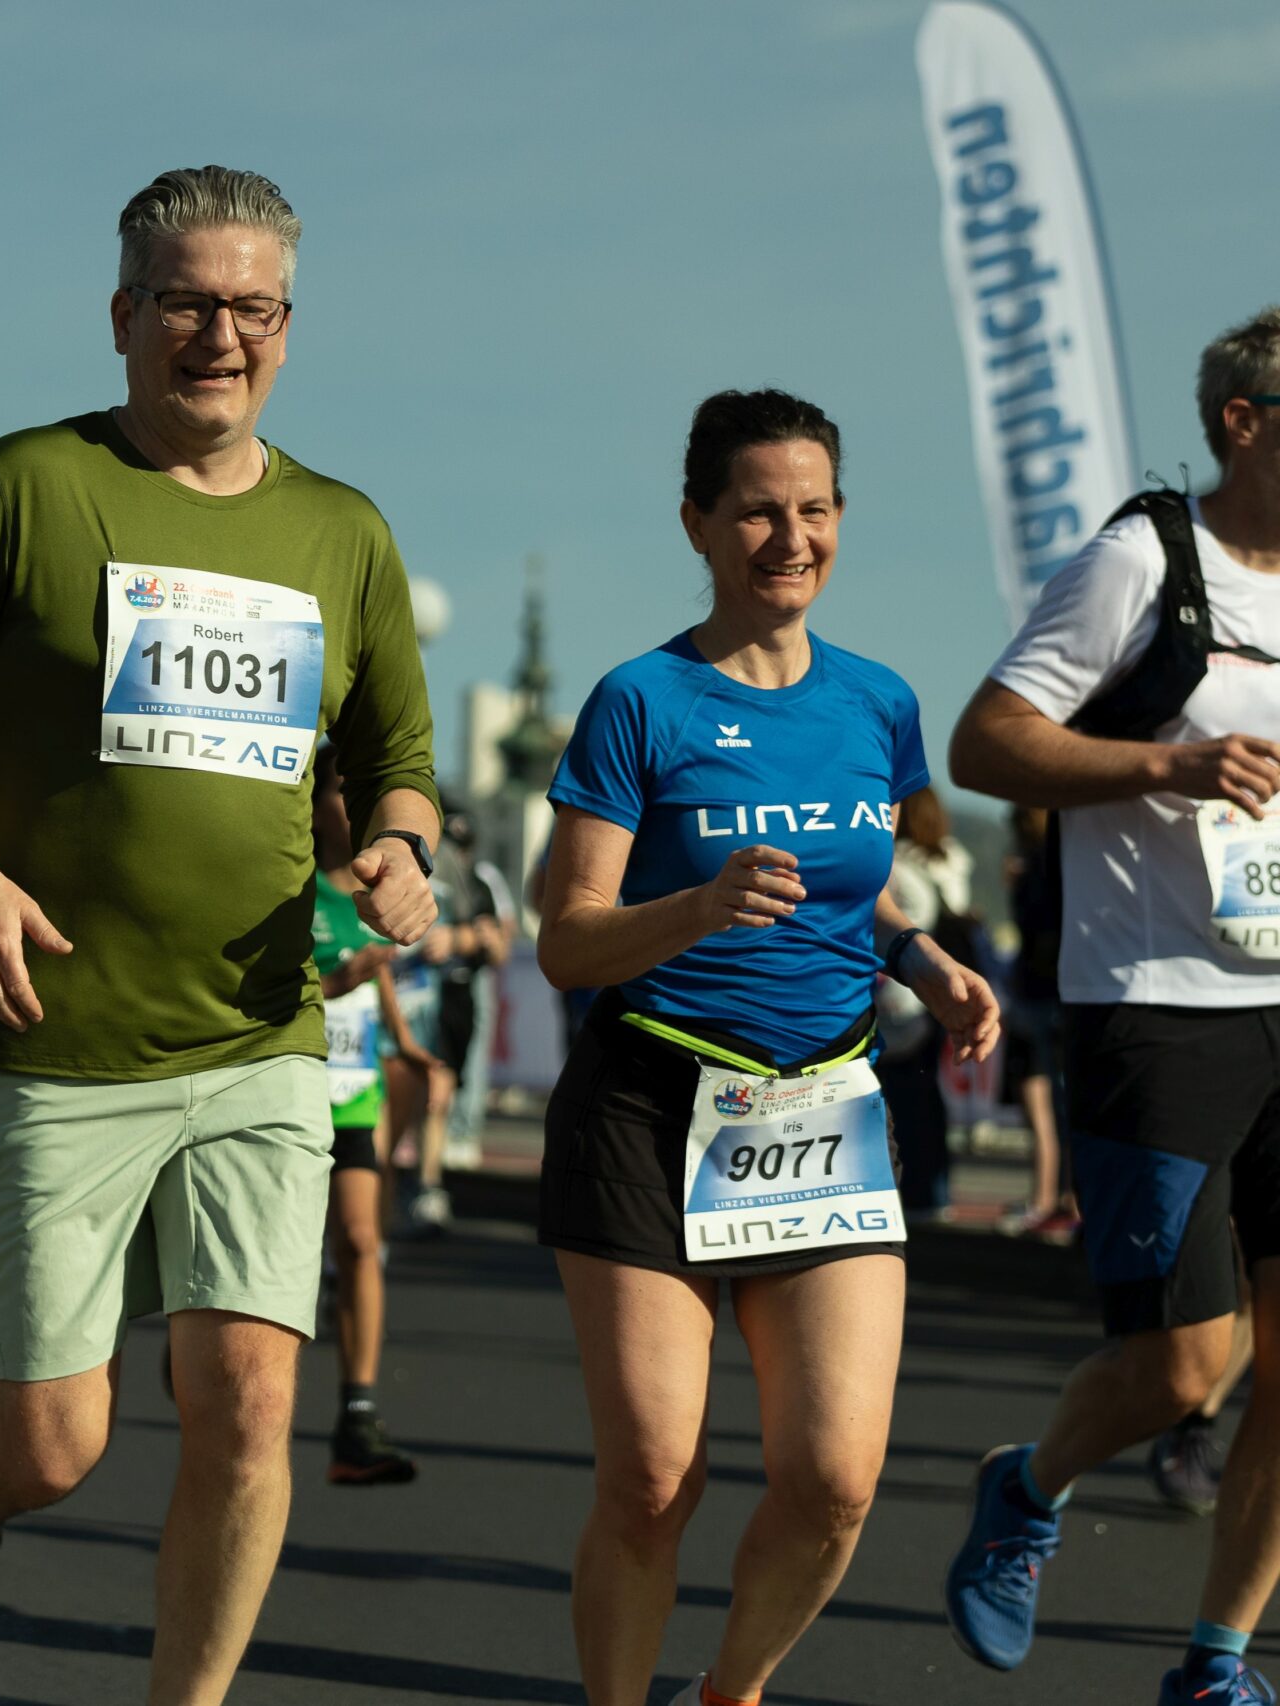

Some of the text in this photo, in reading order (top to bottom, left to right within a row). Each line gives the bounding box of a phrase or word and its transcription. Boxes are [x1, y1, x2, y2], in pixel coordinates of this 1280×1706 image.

[173, 582, 188, 592] 22.
[129, 595, 162, 606] 7.4.2024
[173, 602, 235, 617] MARATHON
[201, 597, 235, 609] DONAU
[194, 624, 244, 644] Robert
[141, 641, 287, 703] 11031
[138, 704, 288, 724] LINZAG VIERTELMARATHON
[117, 726, 299, 771] LINZ AG
[715, 738, 752, 748] erima
[697, 803, 836, 837] LINZ
[783, 1121, 803, 1134] Iris
[727, 1134, 844, 1182] 9077
[715, 1184, 864, 1209] LINZAG VIERTELMARATHON
[699, 1209, 888, 1248] LINZ AG
